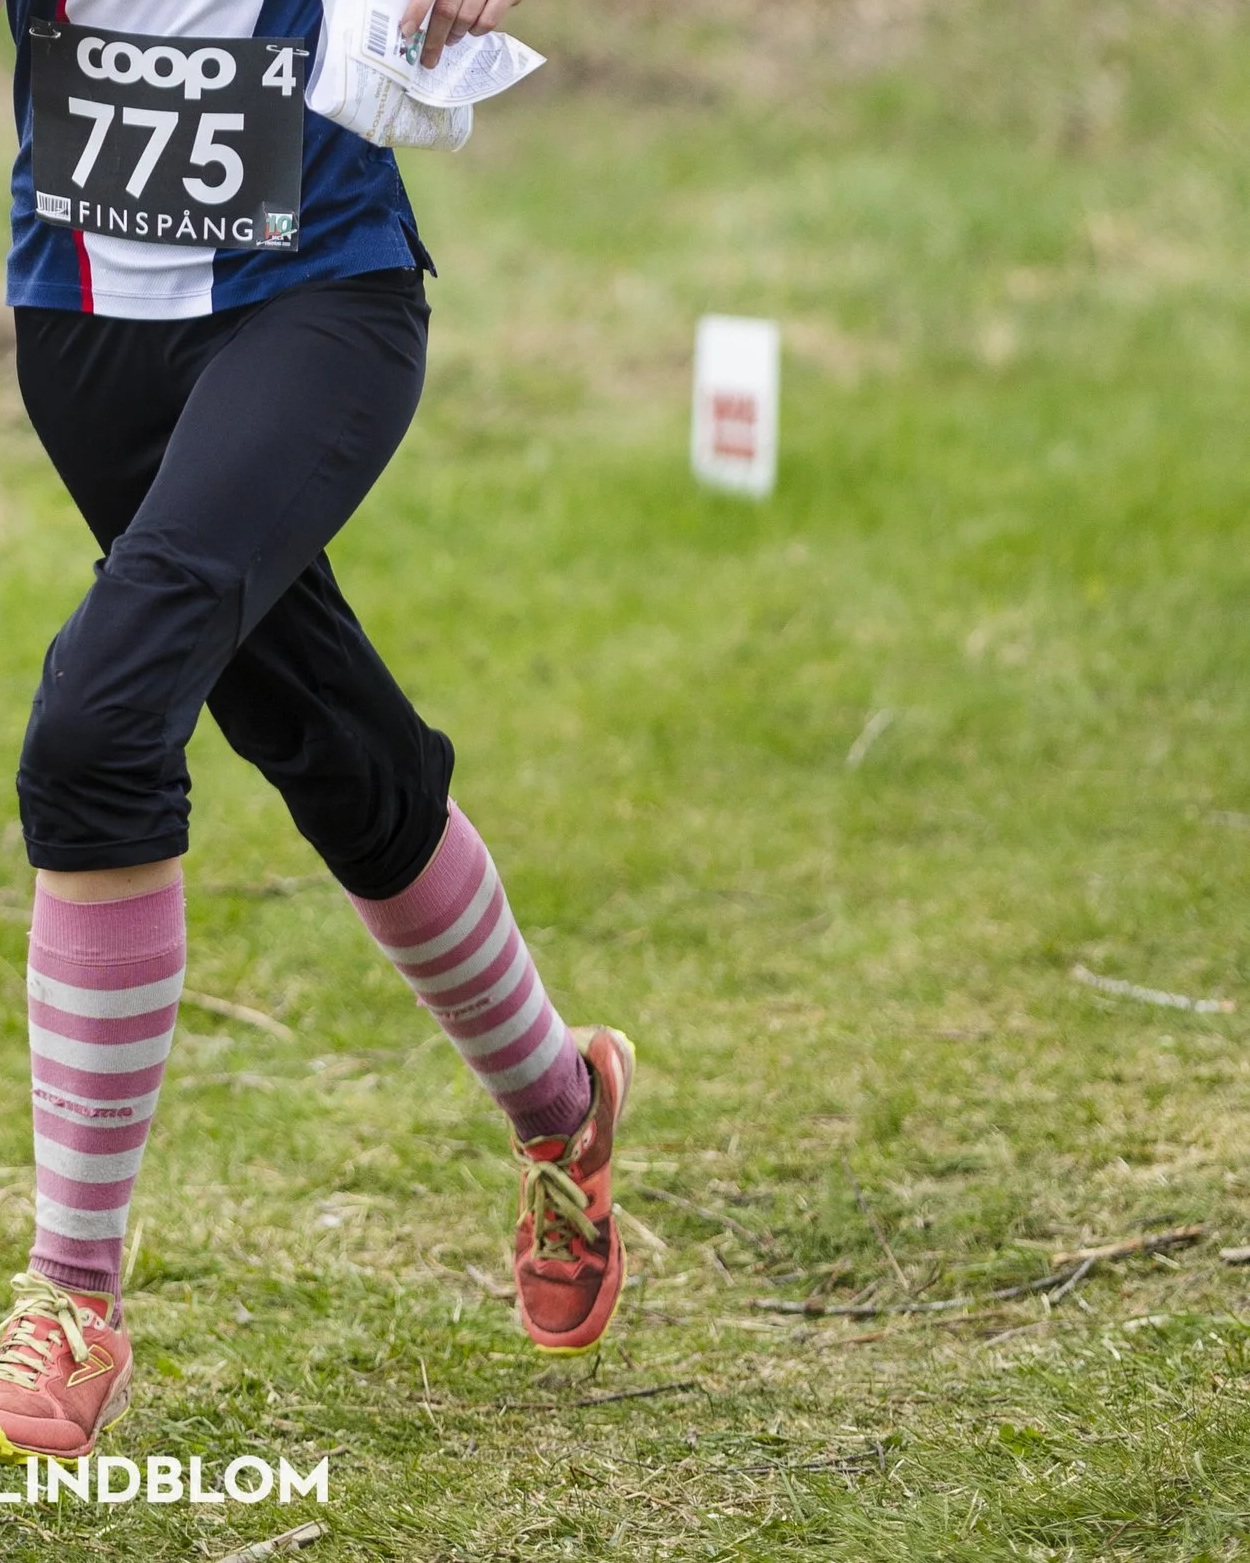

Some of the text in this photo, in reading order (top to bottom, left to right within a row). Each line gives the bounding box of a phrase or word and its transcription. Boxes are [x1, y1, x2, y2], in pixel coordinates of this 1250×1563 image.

[261, 47, 297, 96] 4
[68, 96, 245, 205] 775
[78, 200, 254, 241] FINSPÅNG
